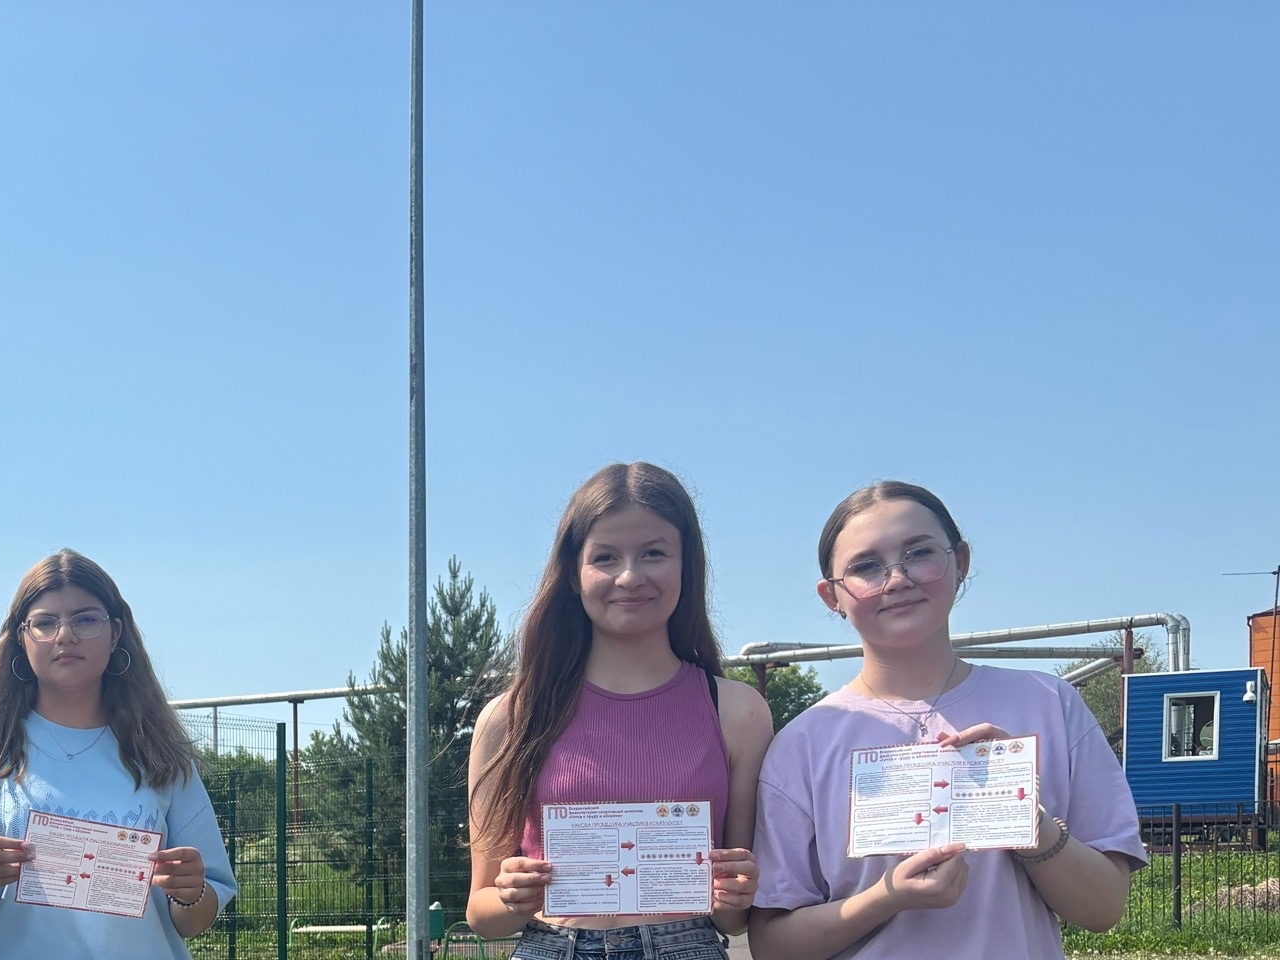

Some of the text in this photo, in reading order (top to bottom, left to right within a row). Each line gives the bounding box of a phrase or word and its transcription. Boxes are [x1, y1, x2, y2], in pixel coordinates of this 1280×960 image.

[857, 751, 878, 765] ГТО
[548, 806, 568, 819] ГТО
[33, 814, 49, 826] ГТО
